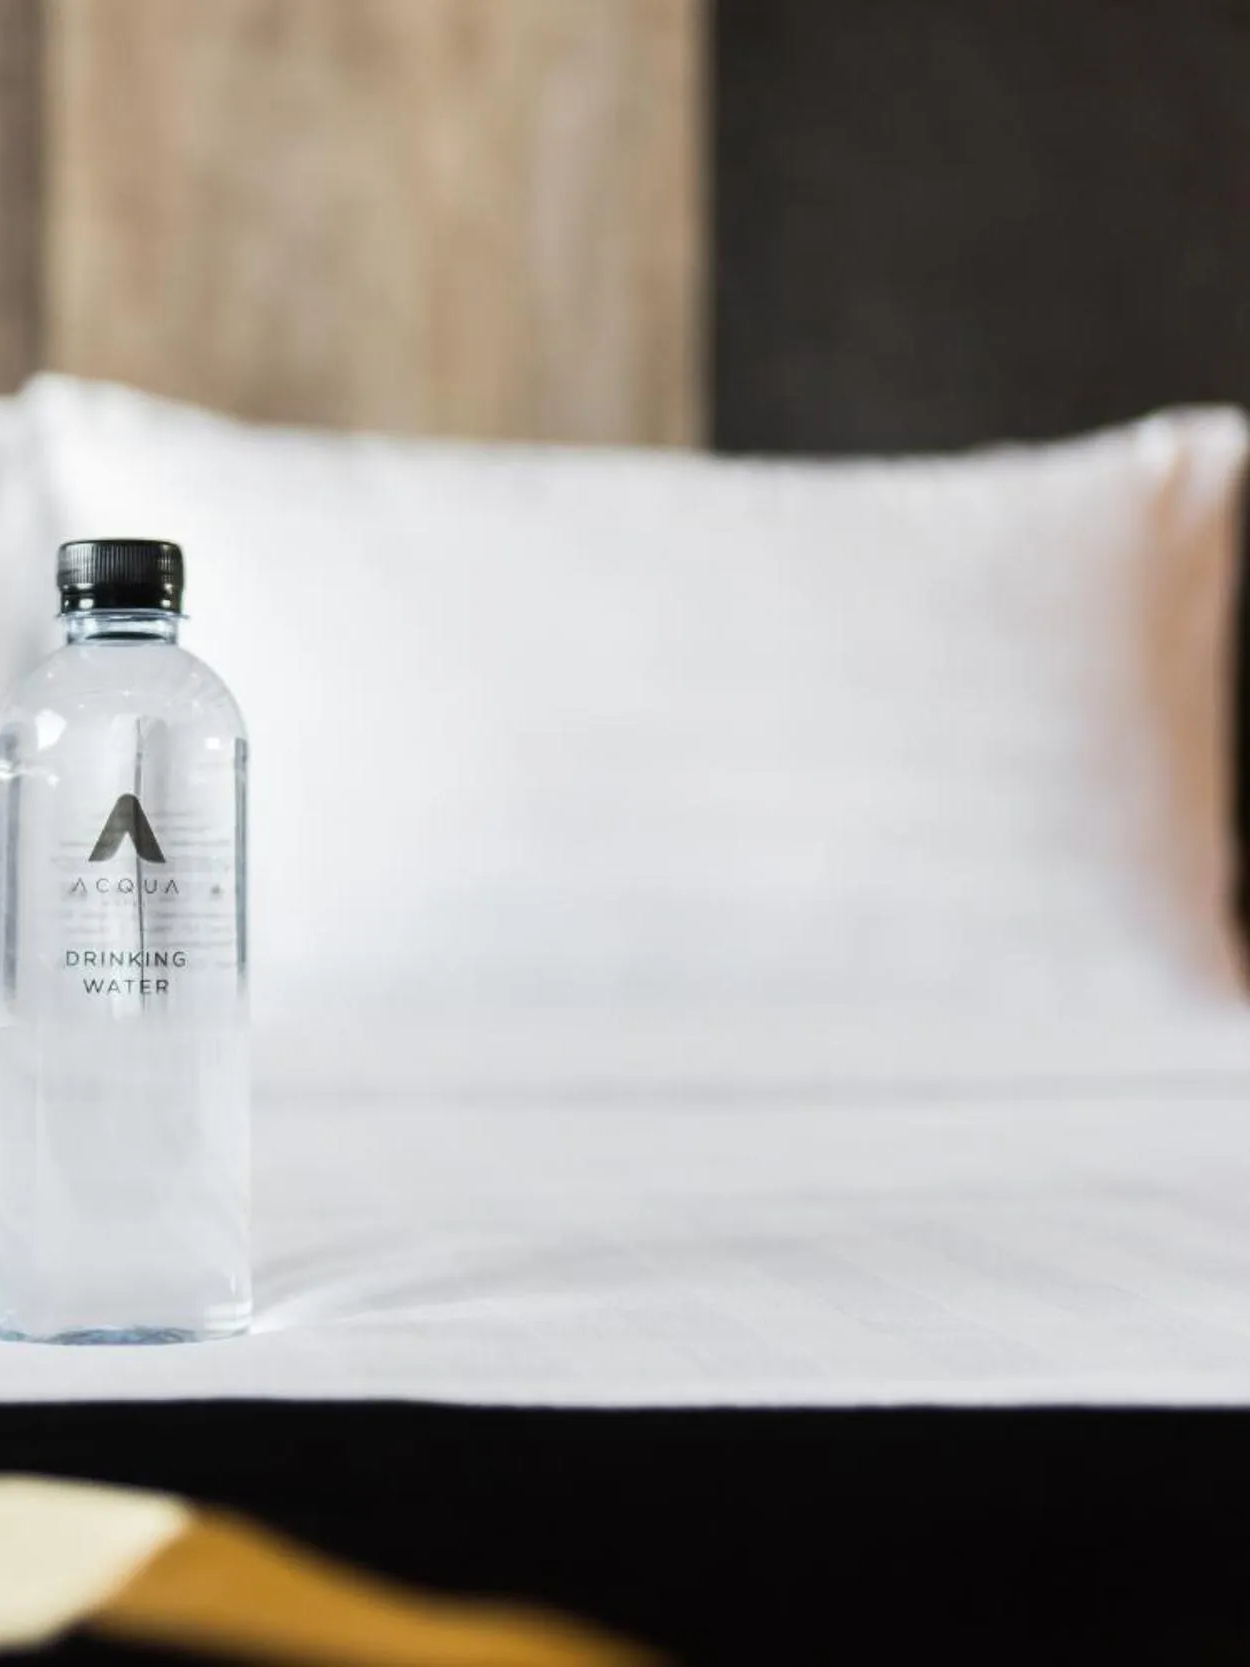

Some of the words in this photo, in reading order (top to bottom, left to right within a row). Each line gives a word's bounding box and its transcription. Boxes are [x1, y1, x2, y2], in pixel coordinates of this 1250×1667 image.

[71, 877, 180, 894] ACQUA
[65, 950, 187, 968] DRINKING
[82, 978, 170, 995] WATER
